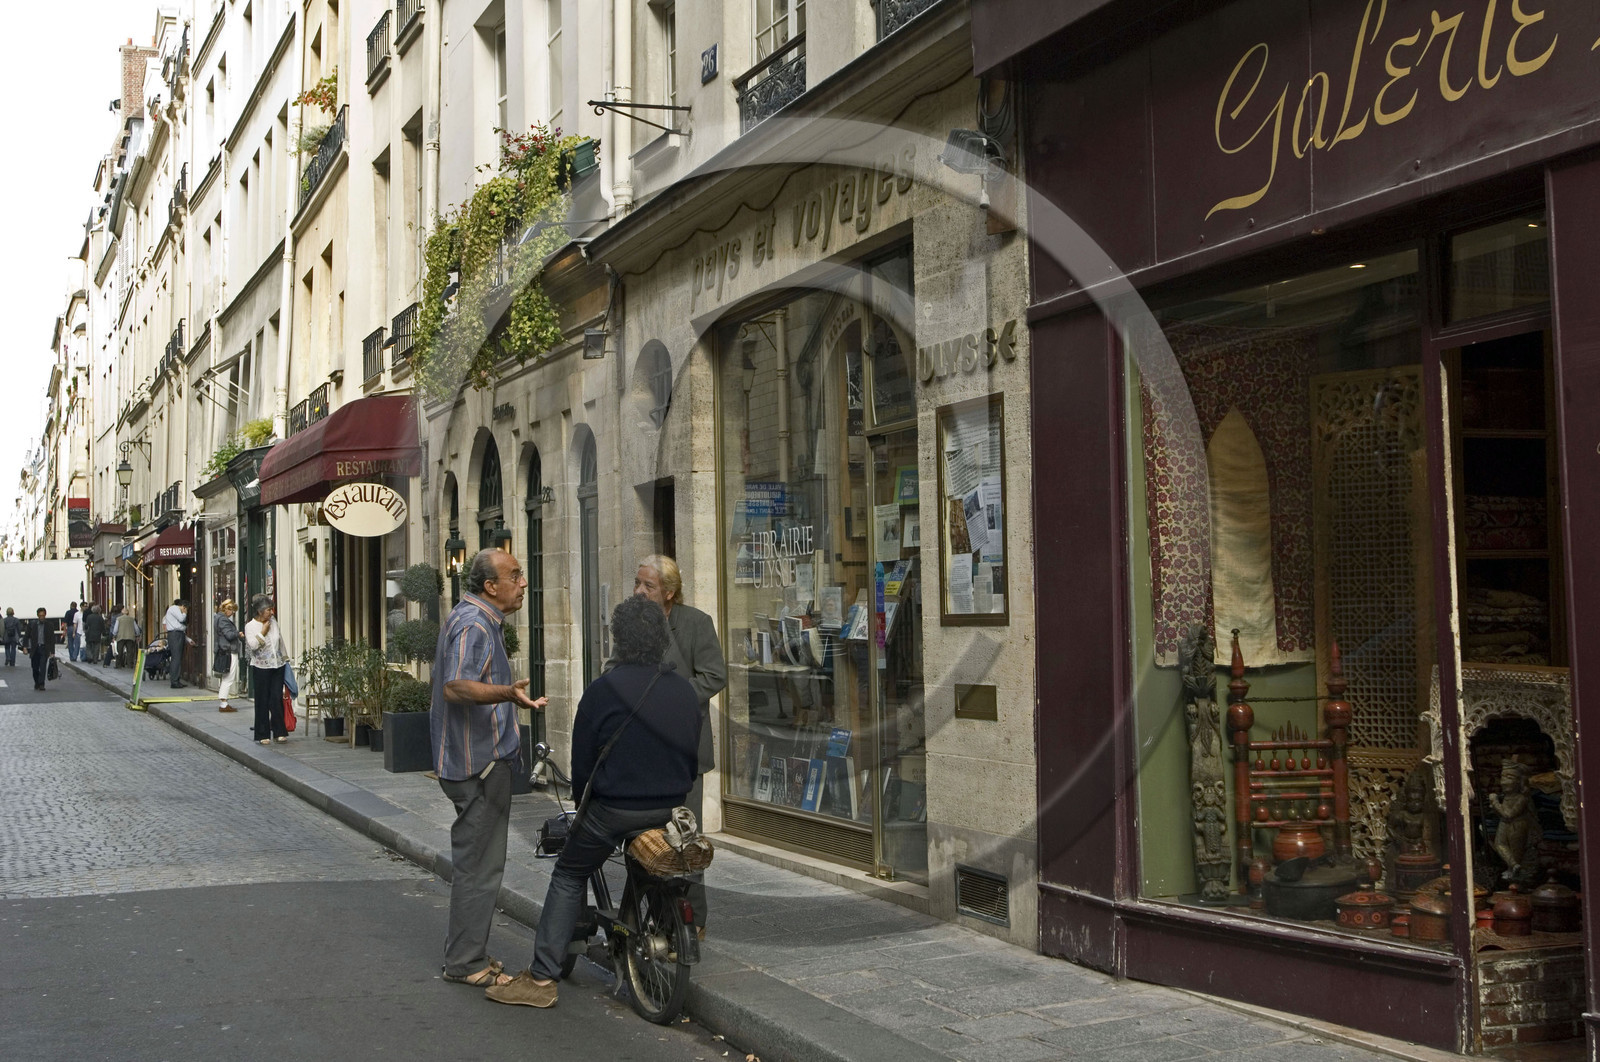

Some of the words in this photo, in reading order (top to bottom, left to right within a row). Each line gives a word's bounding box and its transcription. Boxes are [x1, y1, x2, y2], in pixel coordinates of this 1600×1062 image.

[702, 49, 715, 78] 26
[690, 238, 742, 315] pays
[752, 207, 776, 268] et
[793, 143, 917, 252] voyages
[919, 319, 1017, 382] ULYSSE
[336, 459, 410, 477] RESTAURANT
[324, 485, 406, 522] restaurant
[159, 547, 192, 556] RESTAURANT
[752, 525, 814, 560] LIBRAIRIE
[752, 557, 797, 589] ULYSSE
